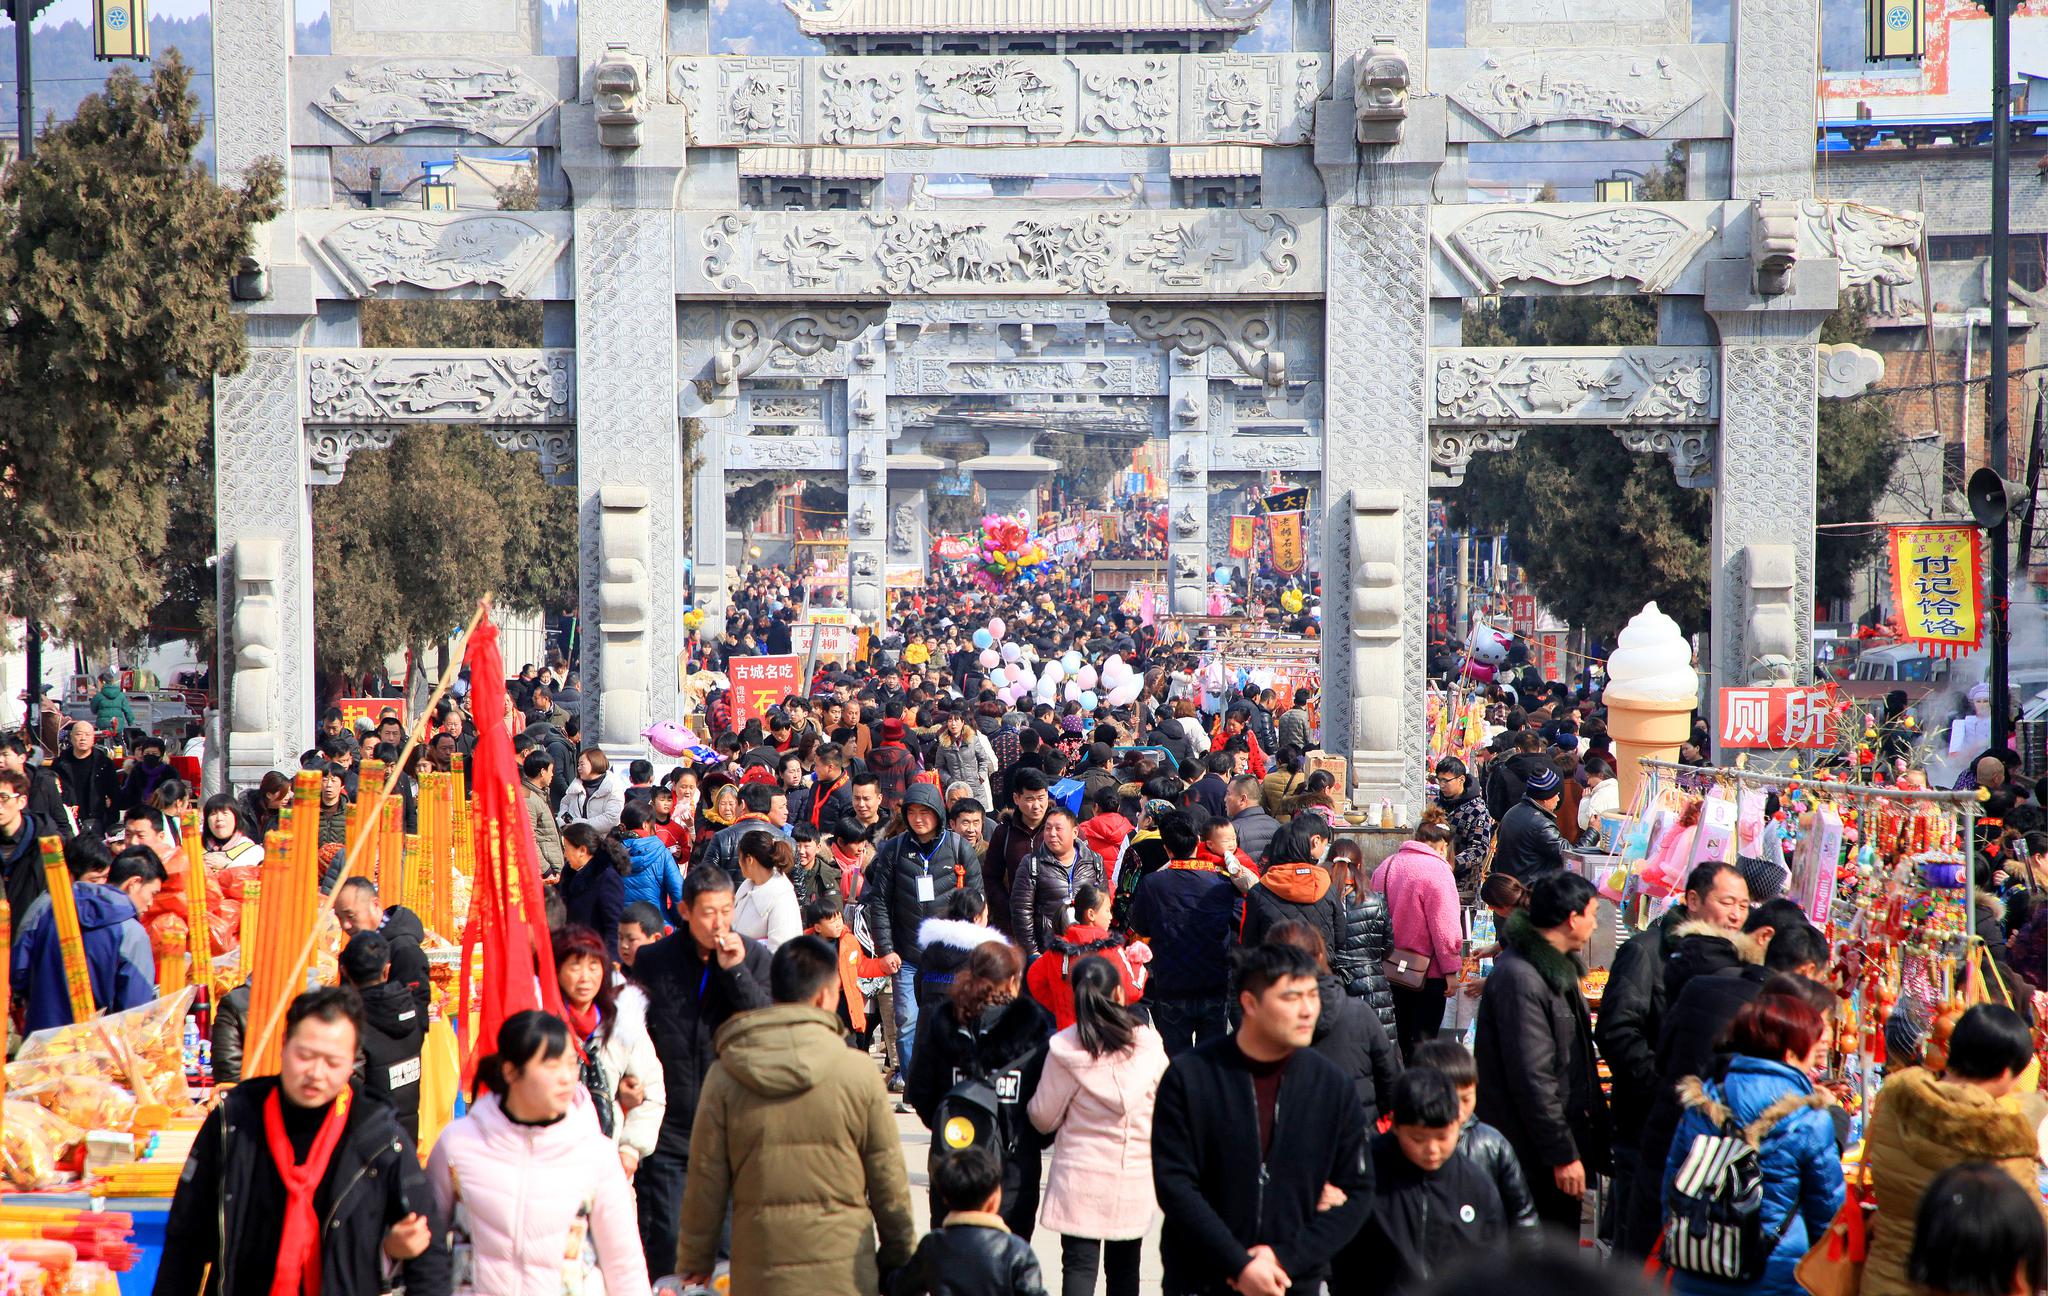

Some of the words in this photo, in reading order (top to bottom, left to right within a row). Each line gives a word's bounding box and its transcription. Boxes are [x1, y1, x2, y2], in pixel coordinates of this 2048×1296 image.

[1912, 555, 1966, 637] 付记饸饹
[735, 663, 794, 680] 古城名吃
[1724, 689, 1829, 745] 厕所
